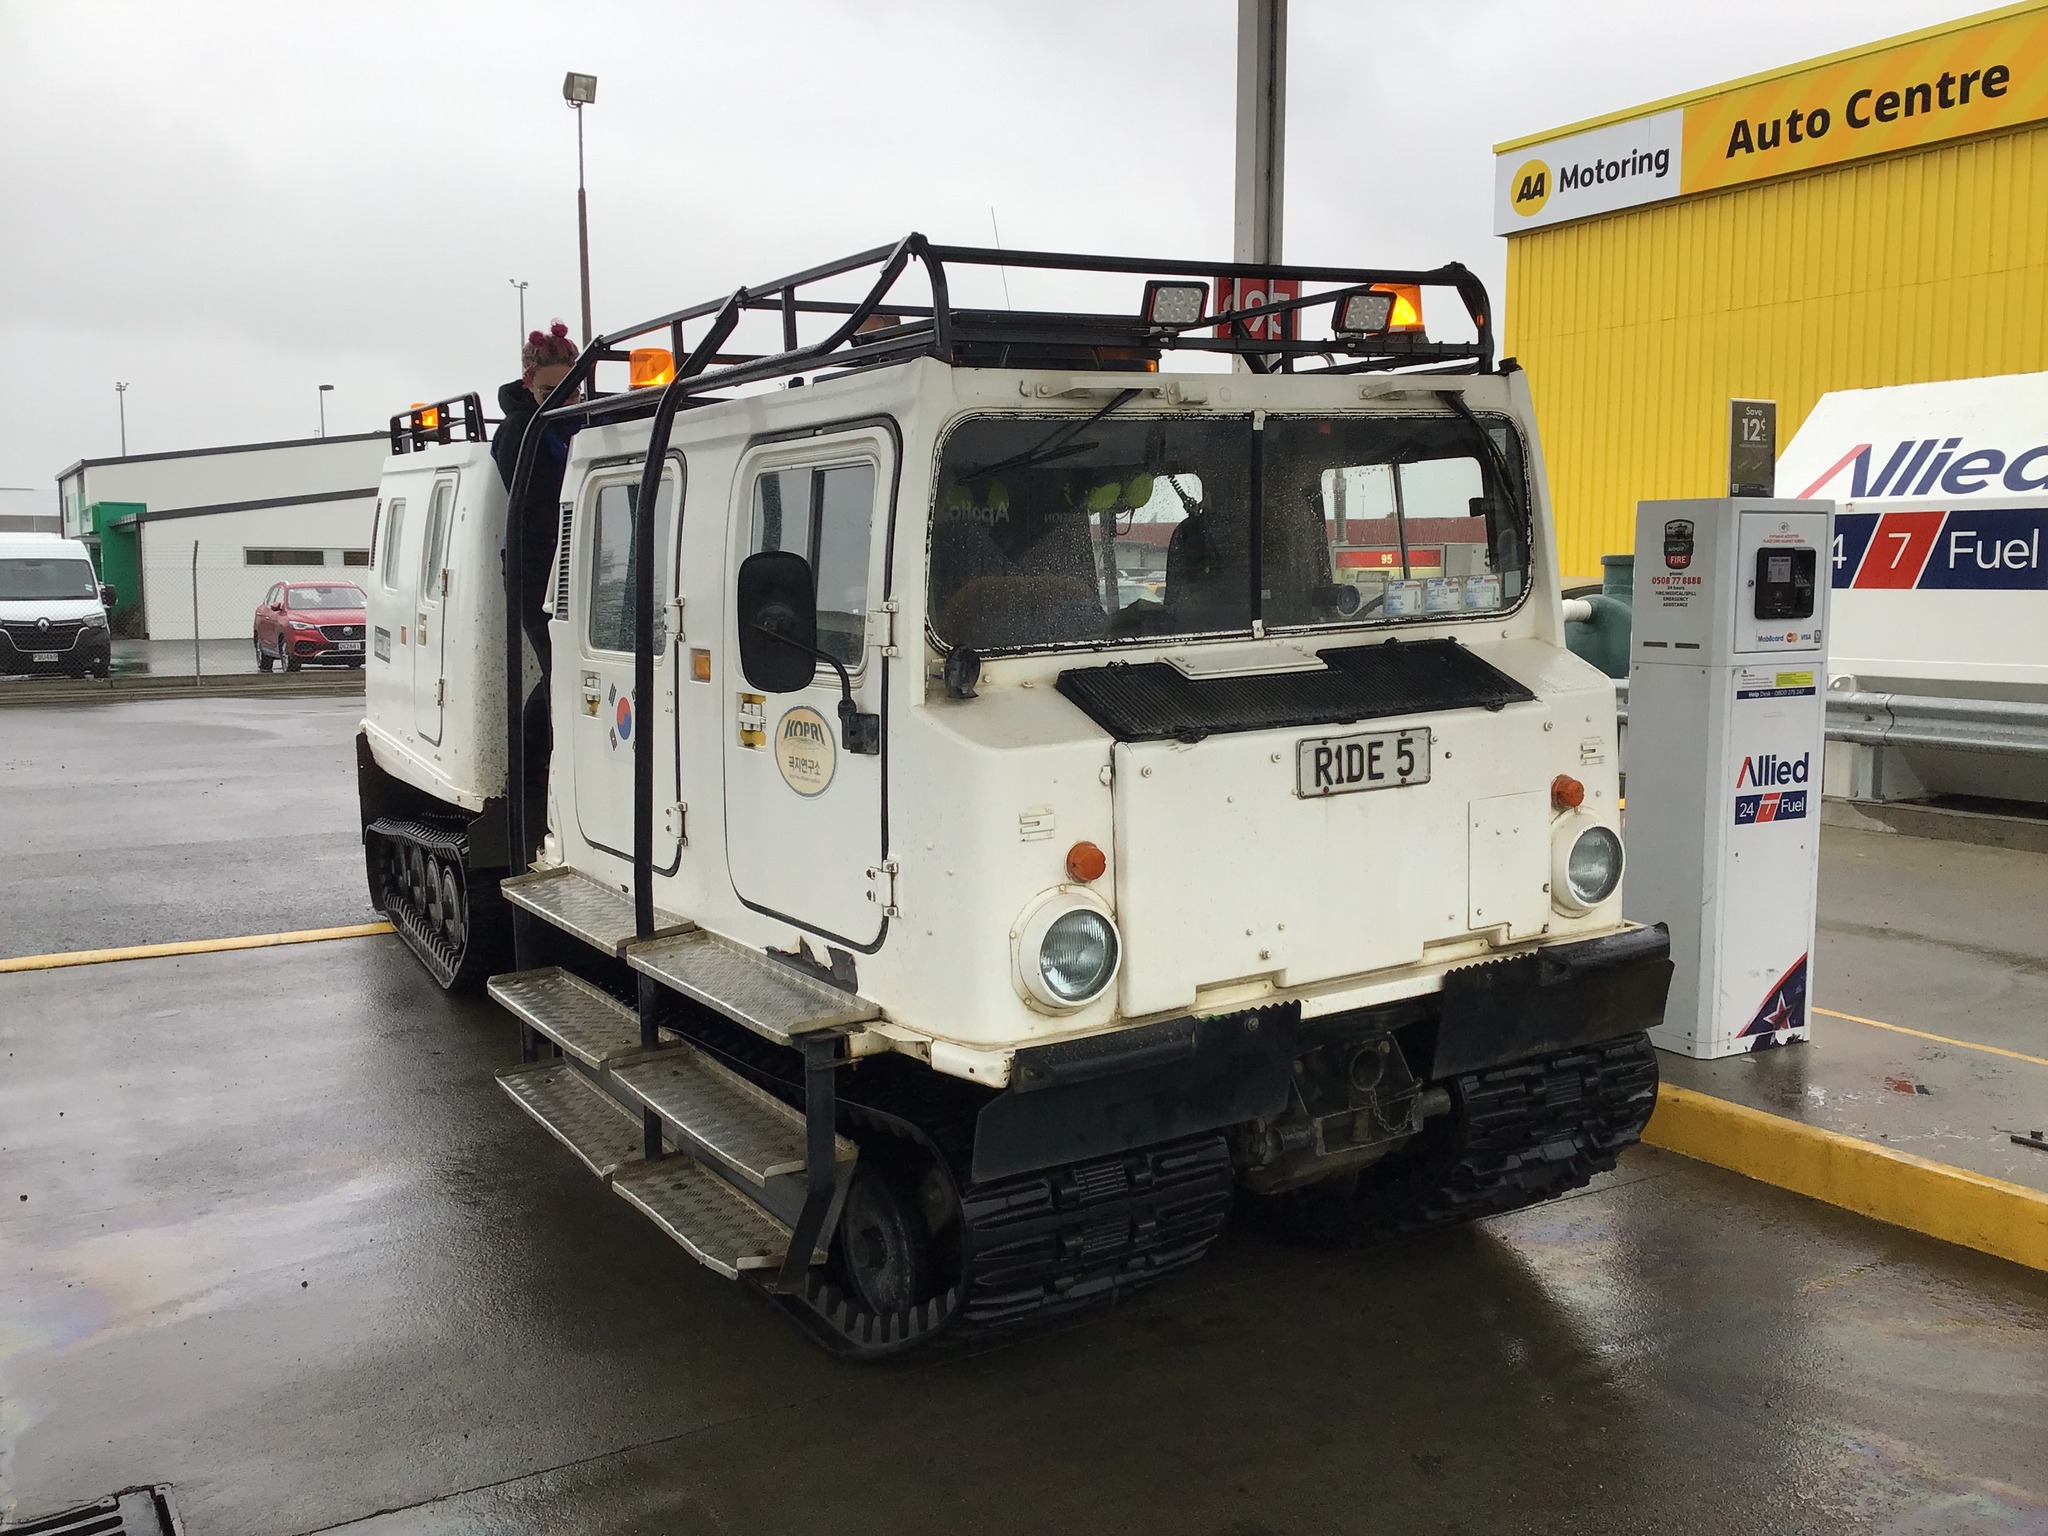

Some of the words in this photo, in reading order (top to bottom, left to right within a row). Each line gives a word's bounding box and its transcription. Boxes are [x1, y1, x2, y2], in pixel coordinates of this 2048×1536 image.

[1726, 108, 1831, 159] Auto
[1845, 63, 2010, 129] Centre
[1515, 172, 1545, 203] AA
[1559, 148, 1670, 193] Motoring
[1746, 406, 1763, 416] Save
[1381, 554, 1393, 564] 95
[1670, 555, 1687, 564] FIRE
[1888, 532, 1912, 569] 7
[1949, 528, 2040, 569] Fuel
[783, 719, 826, 746] KOPRI
[788, 755, 821, 776] 극지연구소
[1397, 737, 1414, 777] 5
[1736, 751, 1810, 789] Allied
[1739, 802, 1754, 818] 24
[1781, 797, 1804, 813] Fuel
